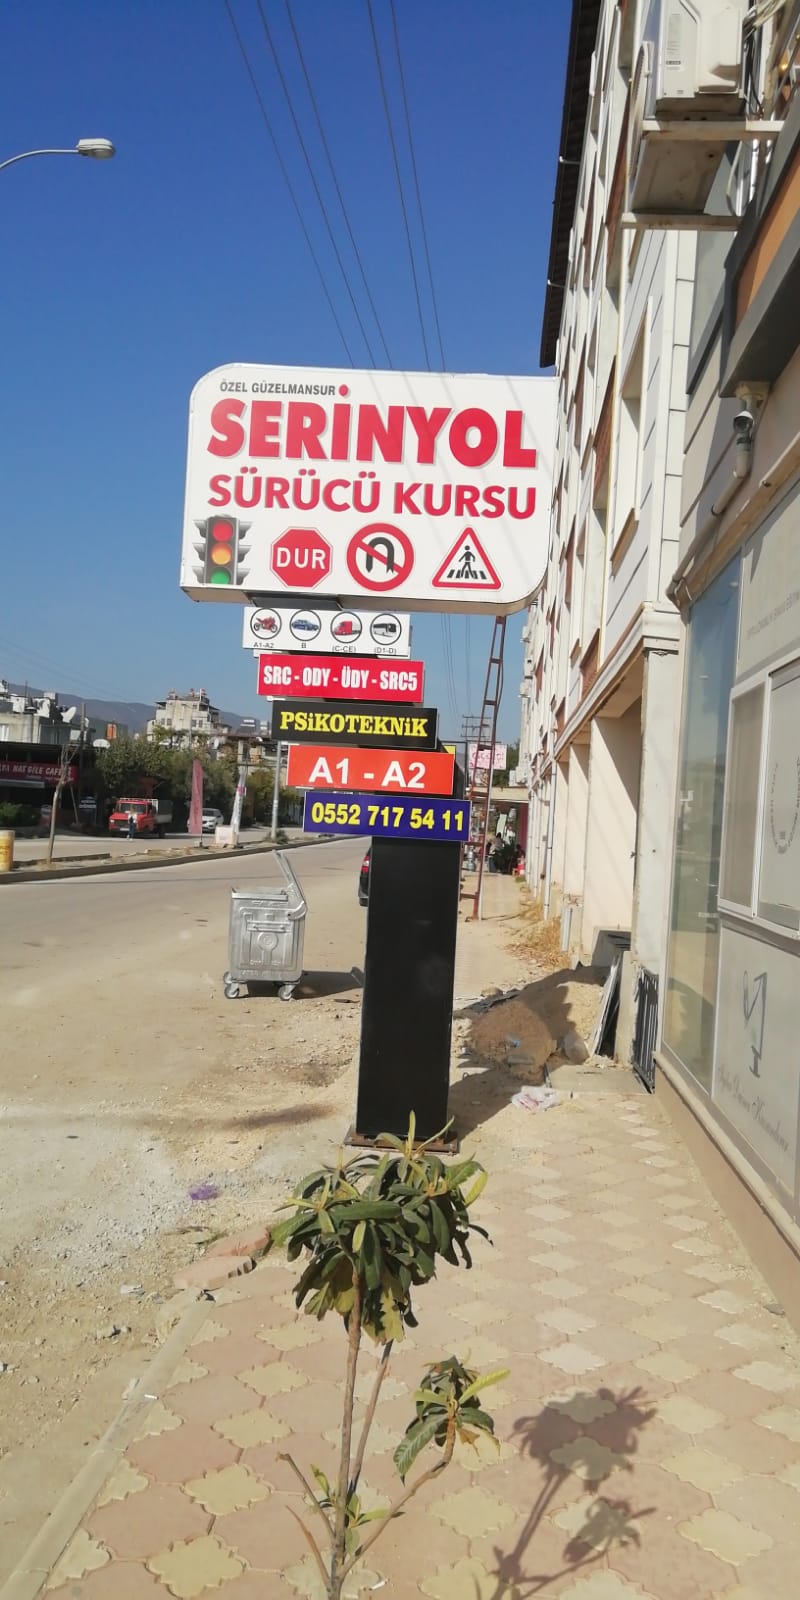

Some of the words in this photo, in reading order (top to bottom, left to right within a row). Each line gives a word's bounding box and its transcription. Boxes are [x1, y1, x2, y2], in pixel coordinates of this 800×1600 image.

[219, 378, 248, 394] ÖZEL
[251, 379, 336, 397] GÜZELMANSUR
[207, 384, 537, 469] SERİNYOL
[208, 467, 381, 513] SÜRÜCÜ
[394, 482, 537, 519] KURSU
[275, 546, 326, 570] DUR
[263, 665, 292, 685] SRC
[302, 667, 331, 687] ODY
[341, 665, 370, 689] ÜDY
[379, 673, 418, 691] SRC5
[308, 757, 349, 785] A1
[381, 761, 426, 789] A2
[311, 802, 361, 826] 0552
[367, 805, 404, 828] 717
[410, 807, 435, 830] 54
[441, 810, 464, 832] 11
